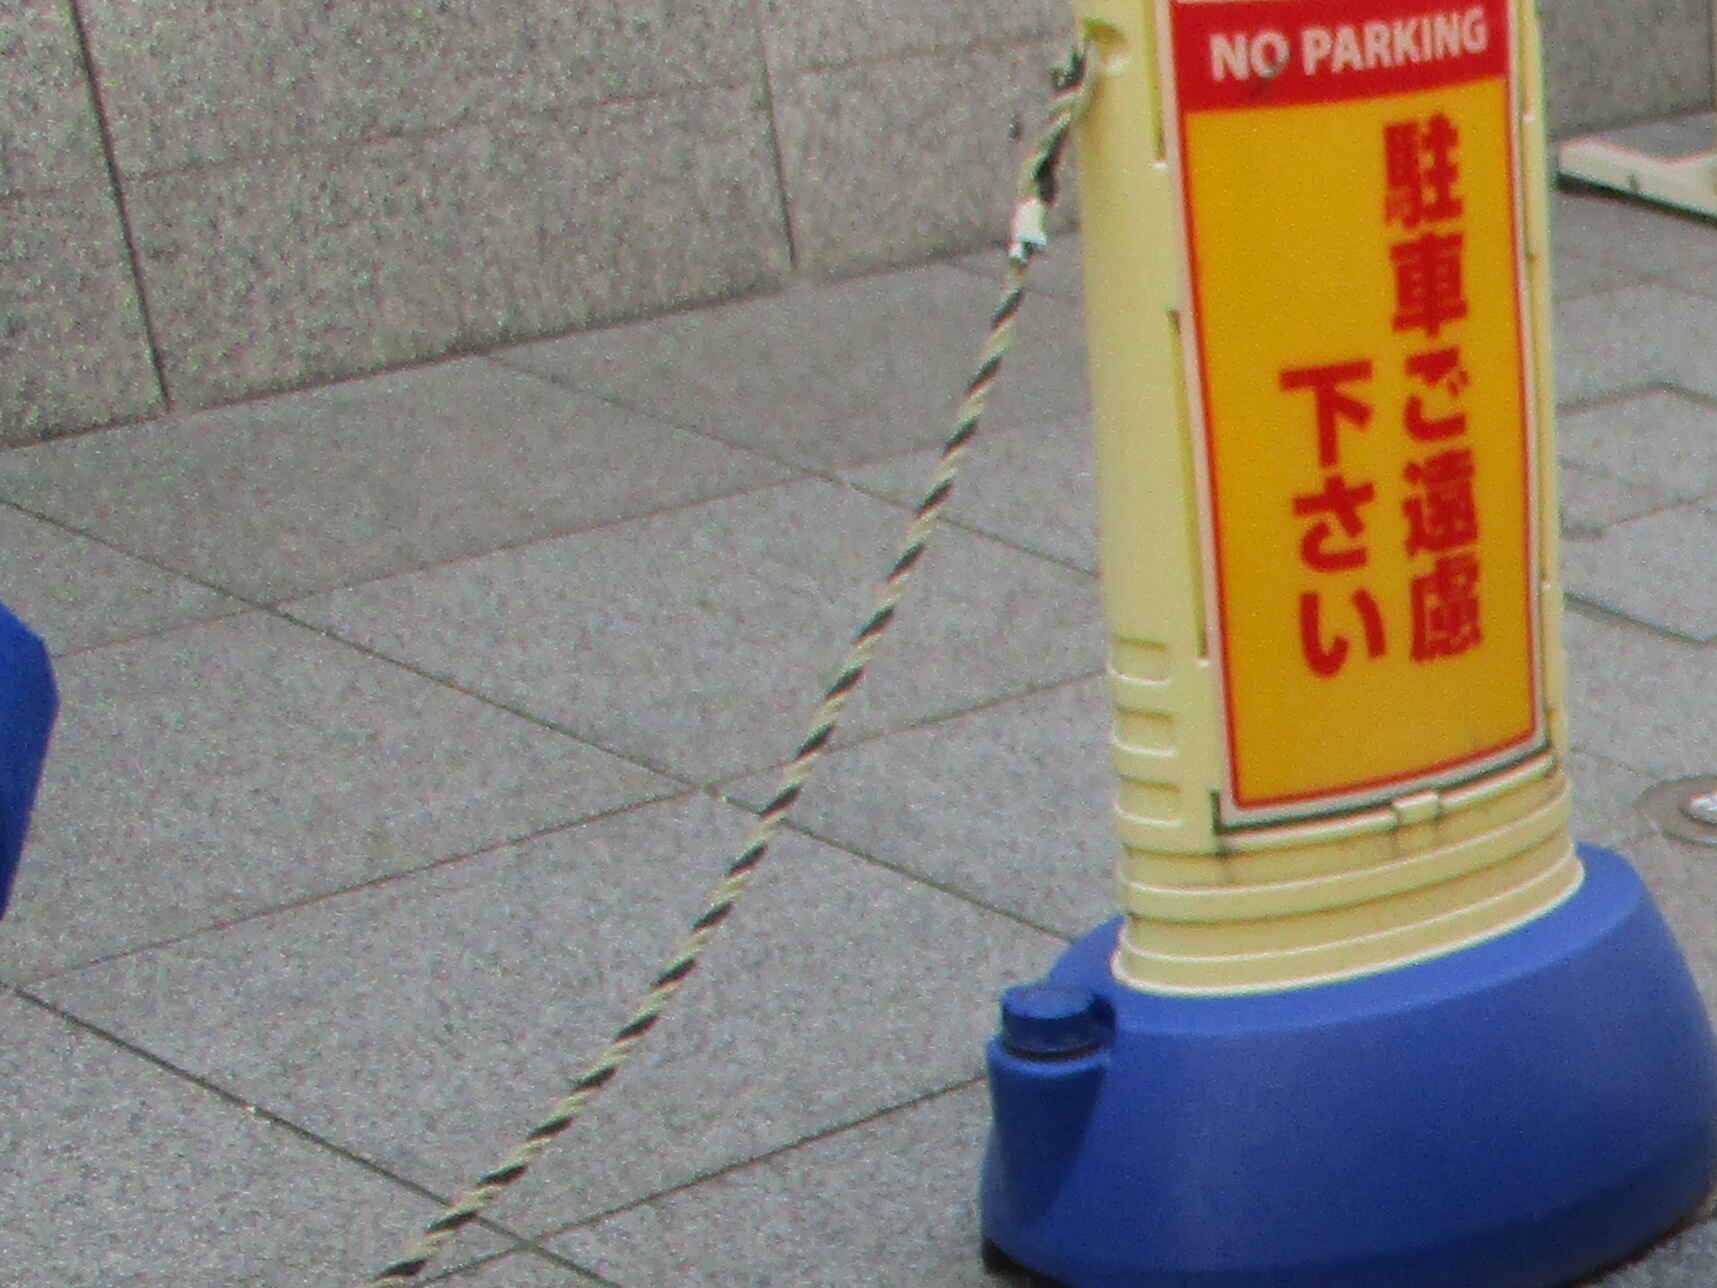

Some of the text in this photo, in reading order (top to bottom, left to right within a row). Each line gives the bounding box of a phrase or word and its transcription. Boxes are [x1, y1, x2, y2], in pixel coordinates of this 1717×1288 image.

[1209, 6, 1489, 80] NO PARKING
[1279, 360, 1385, 679] 下さい
[1382, 113, 1483, 663] 駐車ご遠慮
